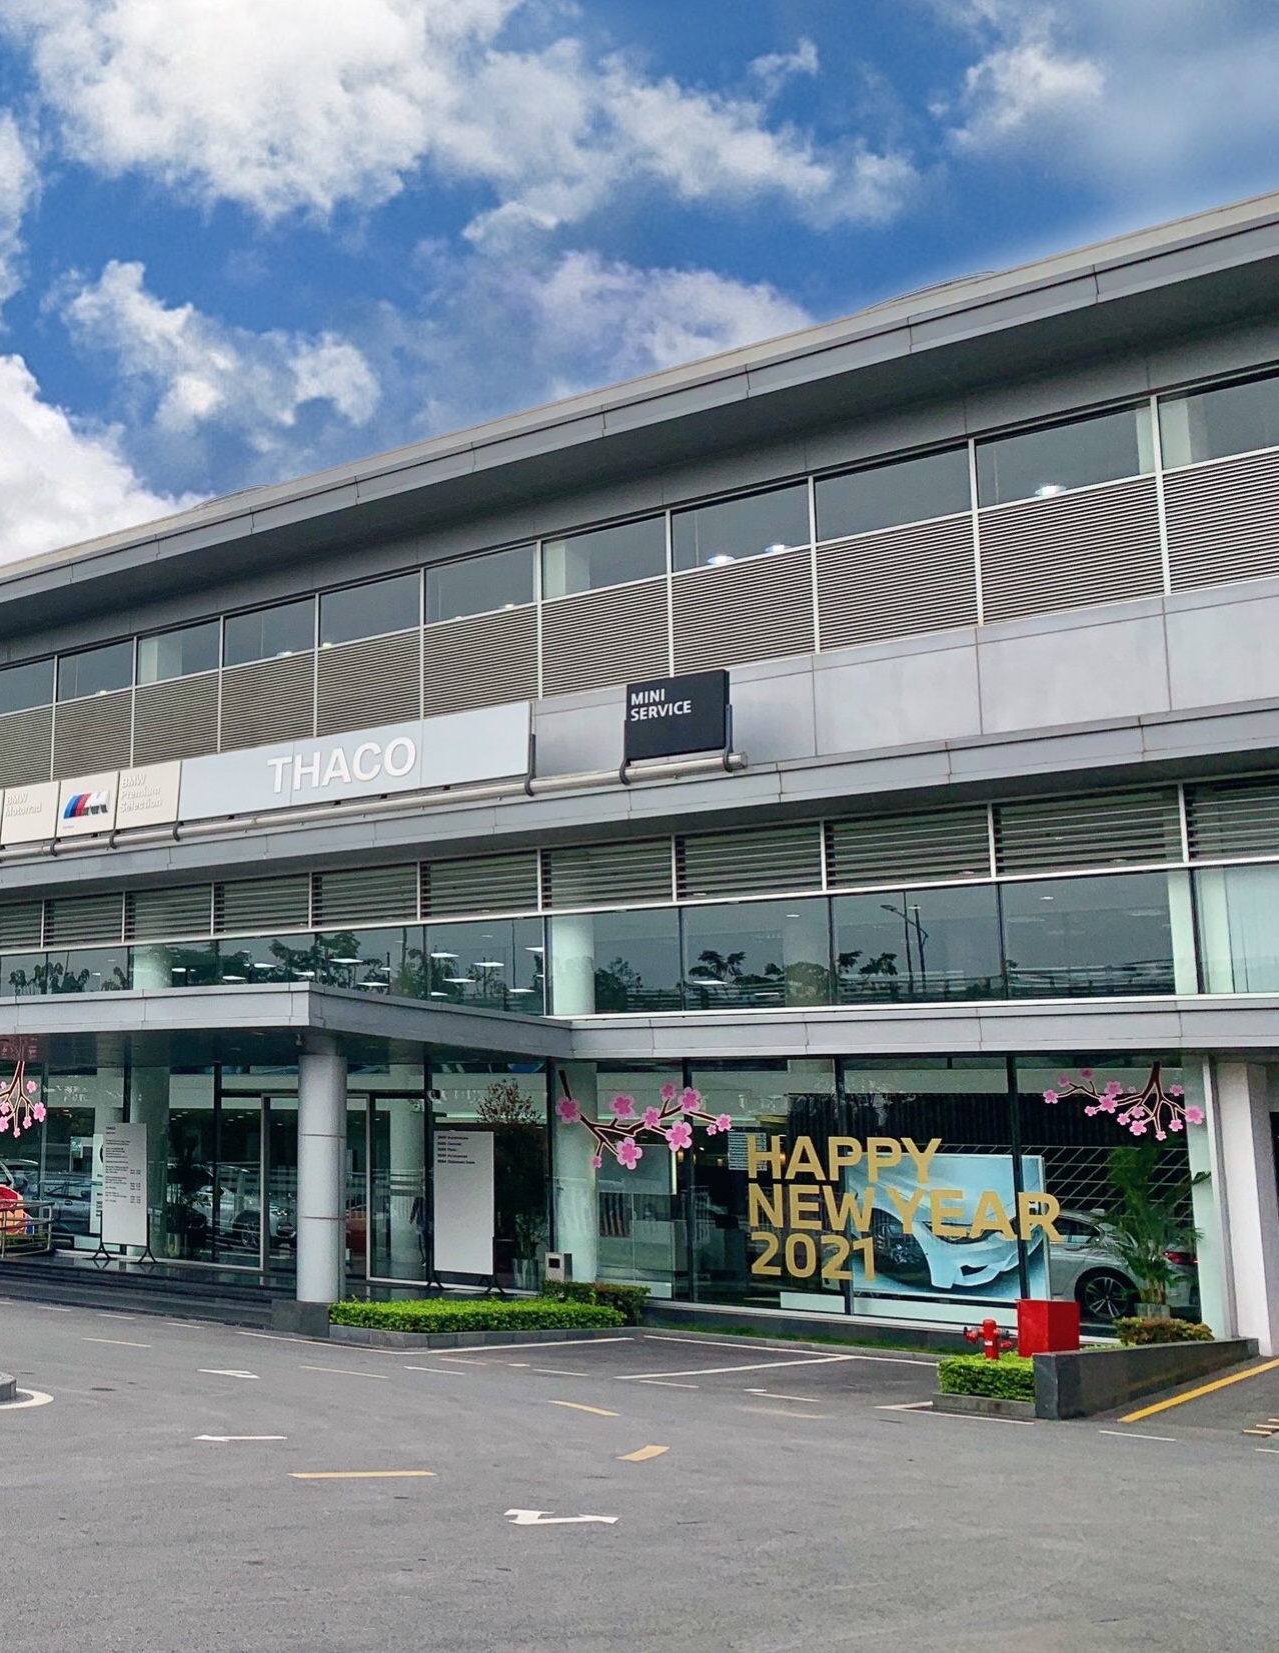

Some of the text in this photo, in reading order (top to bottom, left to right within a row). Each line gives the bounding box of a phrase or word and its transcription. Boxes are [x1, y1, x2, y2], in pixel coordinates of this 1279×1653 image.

[630, 688, 666, 706] MINI
[630, 700, 692, 721] SERVICE
[266, 736, 417, 794] THACO
[122, 774, 146, 787] BMW
[7, 793, 28, 805] BMW
[121, 786, 161, 800] Premium
[6, 802, 42, 817] Motorrad
[121, 798, 163, 812] Selection
[746, 1134, 942, 1184] HAPPY
[748, 1183, 1063, 1242] NEW YEAR
[751, 1231, 876, 1281] 2021
